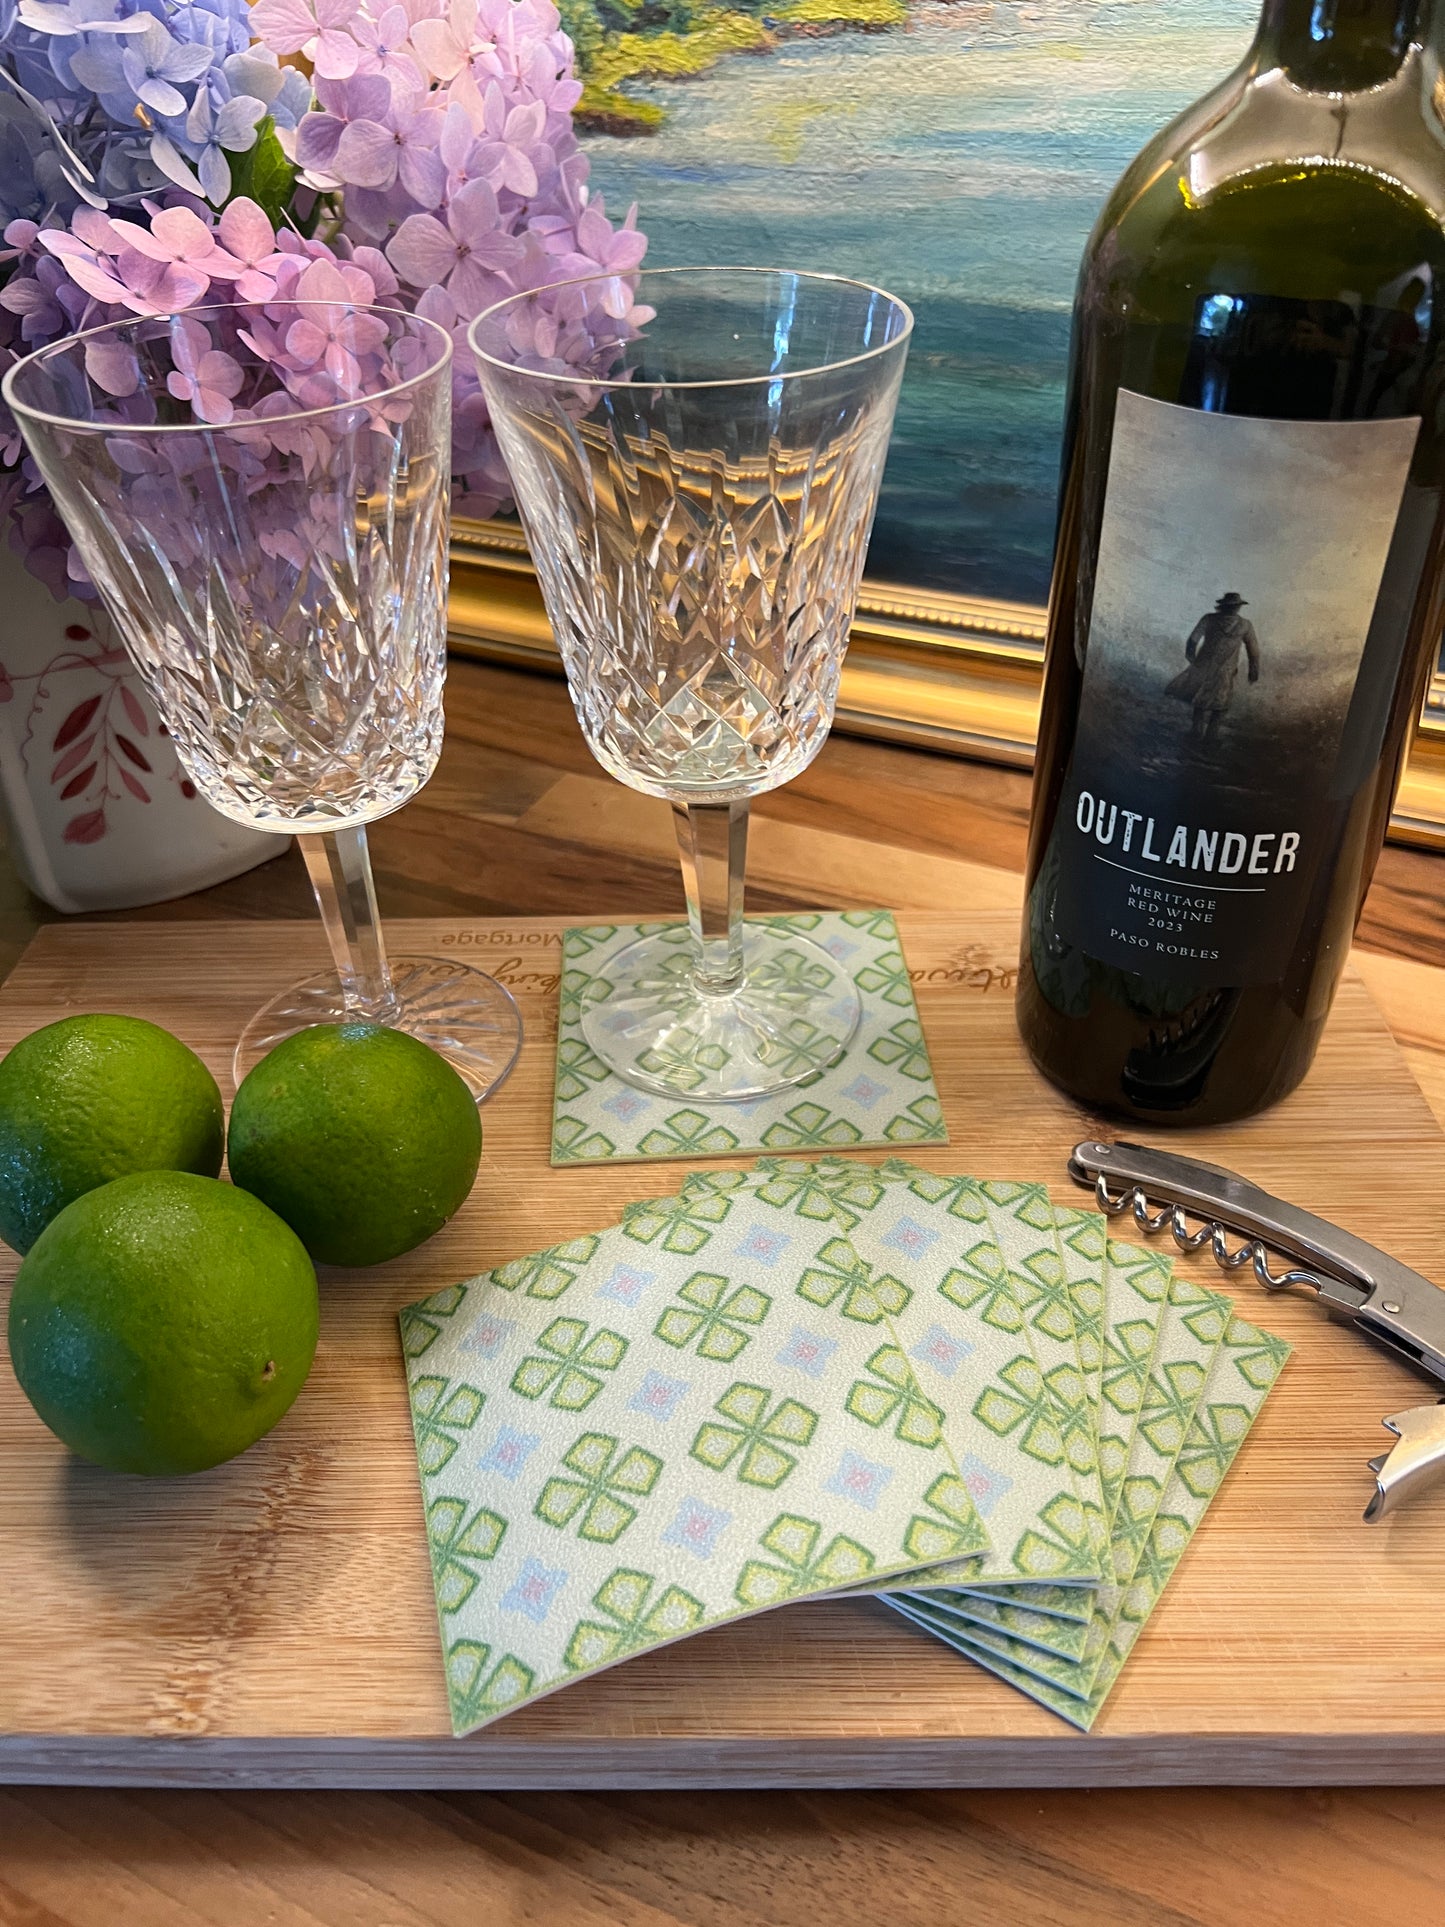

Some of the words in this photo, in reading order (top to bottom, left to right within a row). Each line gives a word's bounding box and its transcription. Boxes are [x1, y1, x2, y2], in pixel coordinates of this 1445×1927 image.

[1076, 790, 1301, 875] OUTLANDER
[1127, 897, 1160, 914] RED
[1166, 907, 1214, 923] WINE
[1128, 883, 1217, 910] MERITAGE
[1148, 917, 1183, 933] 2023
[441, 929, 564, 949] Mortgage
[1110, 928, 1150, 948] PASO
[1156, 942, 1219, 960] ROBLES
[491, 957, 562, 995] king
